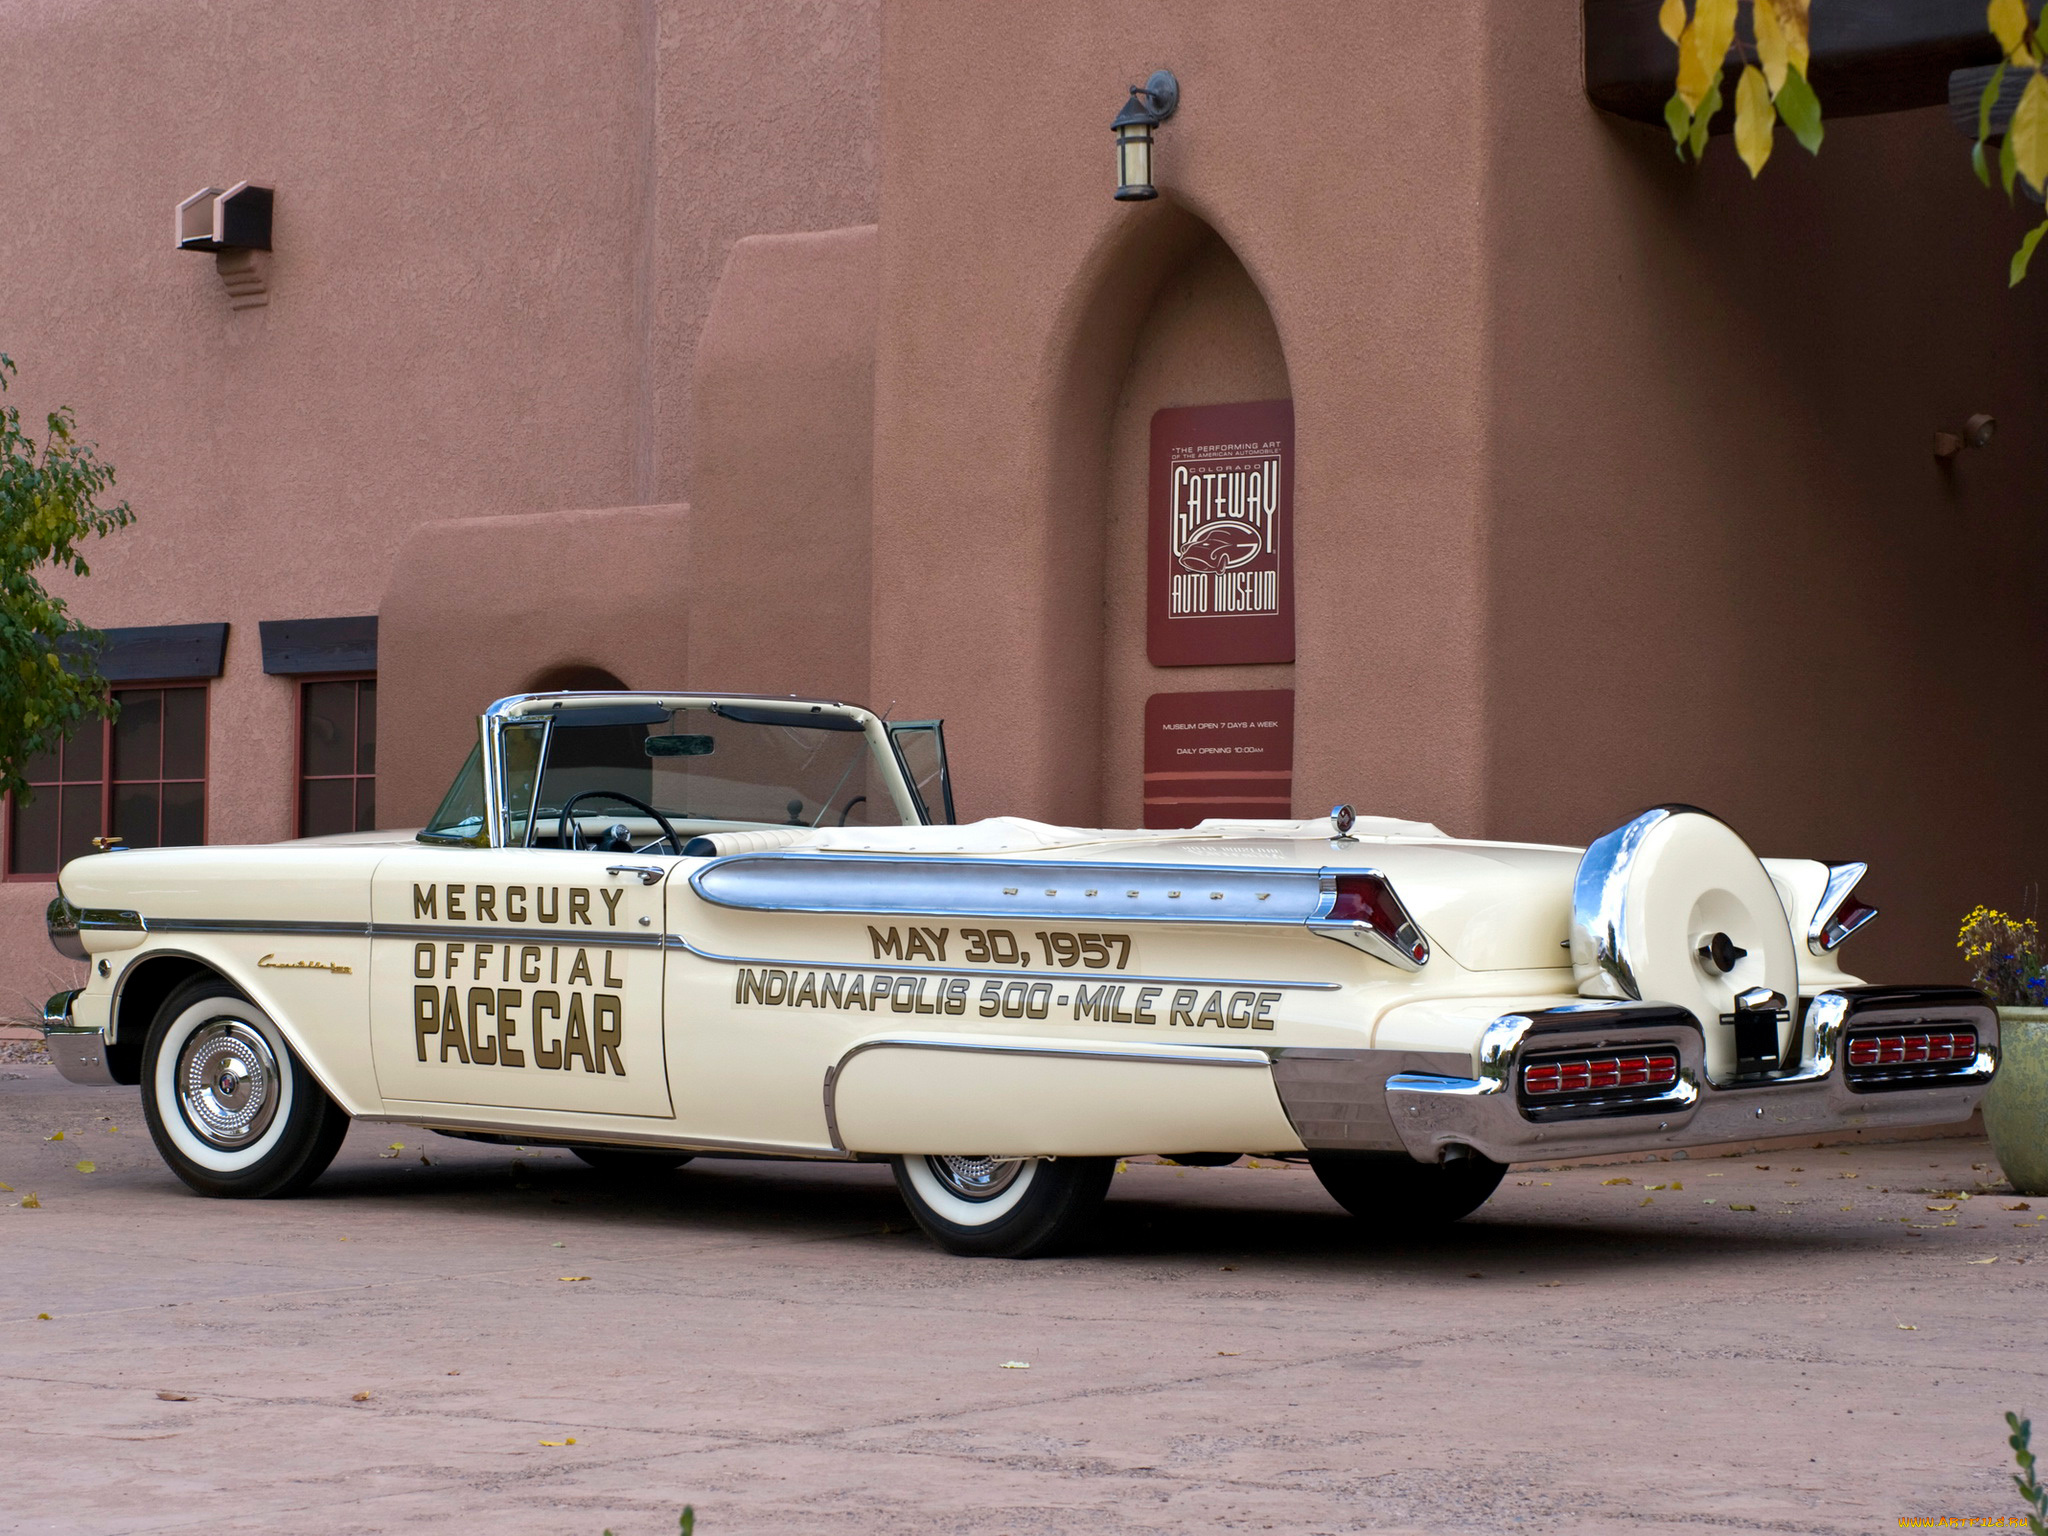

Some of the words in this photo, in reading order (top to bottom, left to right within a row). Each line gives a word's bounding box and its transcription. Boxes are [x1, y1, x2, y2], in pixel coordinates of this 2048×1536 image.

[1189, 464, 1261, 473] COLORADO
[1197, 443, 1259, 452] PERFORMING
[1173, 460, 1278, 557] GATEWAY
[1172, 574, 1208, 613] AUTO
[1214, 570, 1276, 612] MUSEUM
[413, 883, 624, 926] MERCURY
[414, 943, 623, 988] OFFICIAL
[867, 926, 949, 961] MAY
[960, 928, 1030, 967] 30,
[1035, 931, 1131, 969] 1957
[736, 969, 970, 1015] INDIANAPOLIS
[1169, 989, 1282, 1030] RACE
[414, 985, 525, 1067] PACE
[532, 990, 626, 1076] CAR
